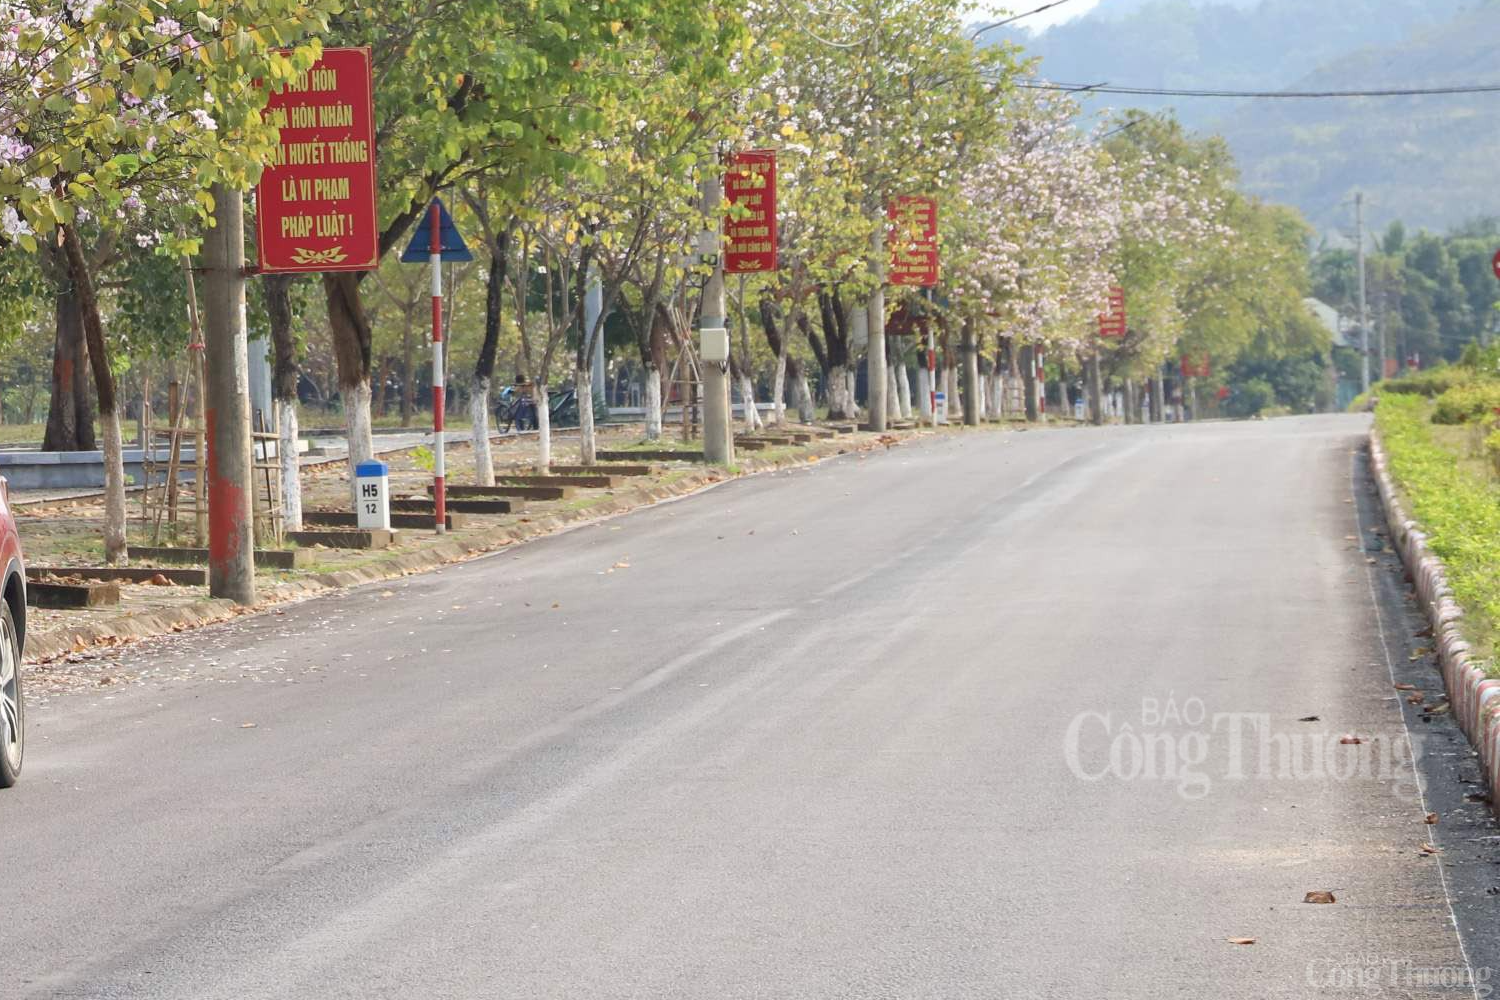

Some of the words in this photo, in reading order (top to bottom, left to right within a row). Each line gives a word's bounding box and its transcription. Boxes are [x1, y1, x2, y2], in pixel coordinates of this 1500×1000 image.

[311, 65, 337, 92] HÔN
[291, 101, 316, 128] HÔN
[319, 100, 353, 128] NHÂN
[289, 134, 325, 165] HUYẾT
[328, 133, 368, 163] THỐNG
[282, 175, 297, 201] LÀ
[300, 179, 312, 201] VI
[314, 178, 349, 205] PHẠM
[281, 211, 313, 238] PHÁP
[316, 210, 345, 241] LUẬT
[362, 484, 378, 497] H5
[365, 503, 377, 515] 12
